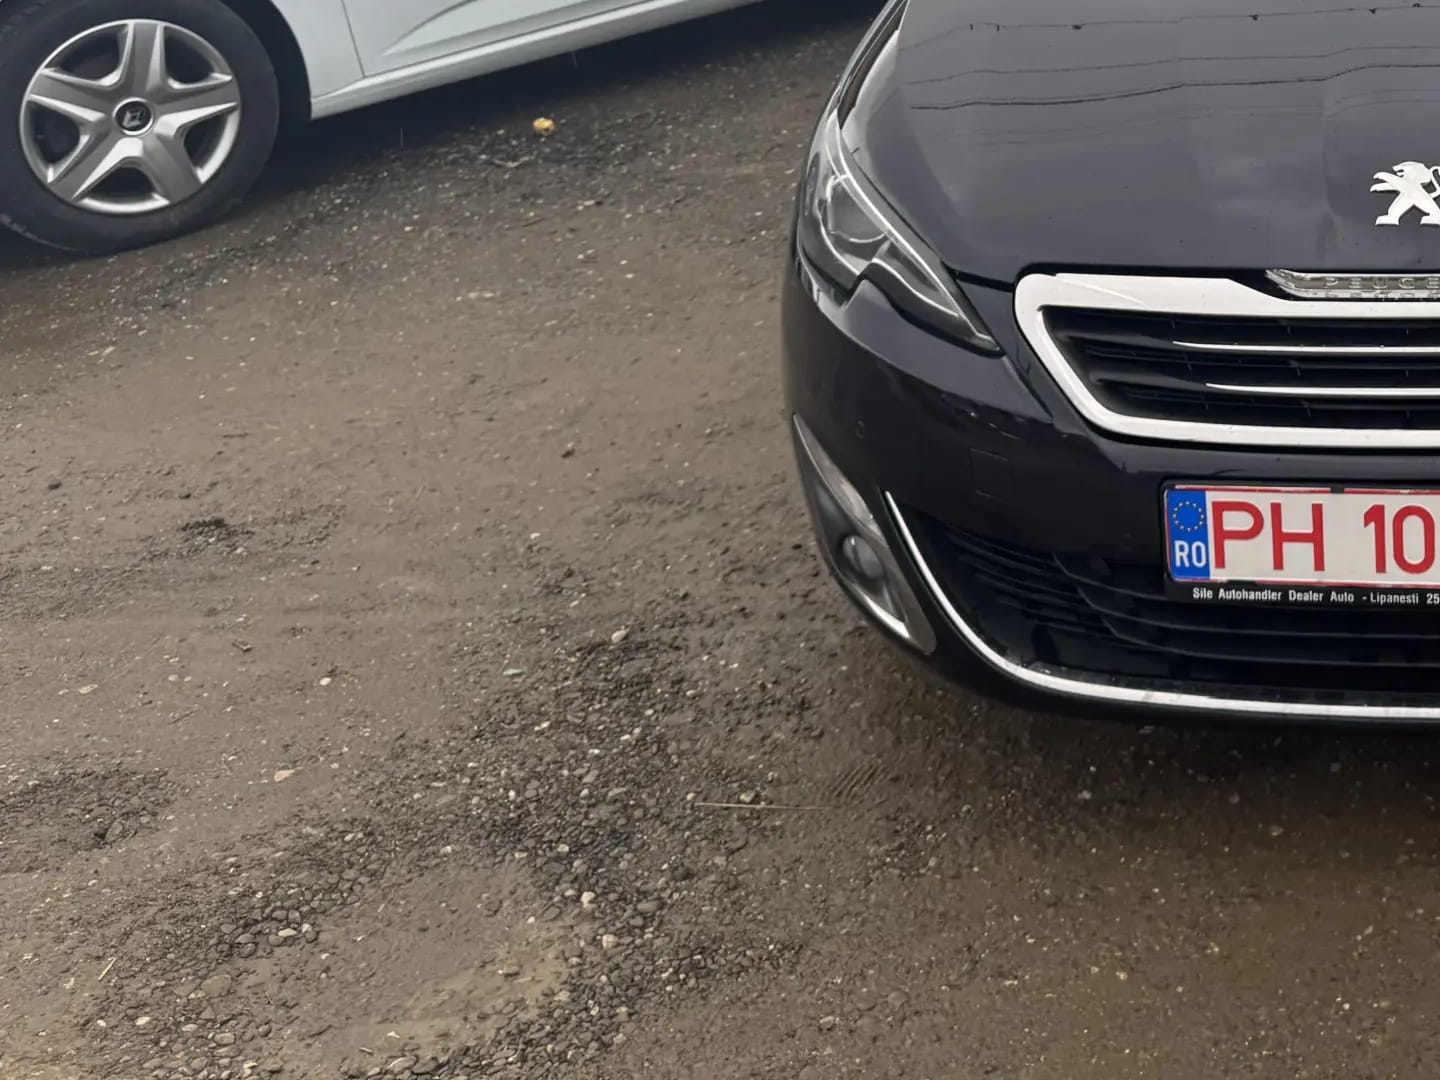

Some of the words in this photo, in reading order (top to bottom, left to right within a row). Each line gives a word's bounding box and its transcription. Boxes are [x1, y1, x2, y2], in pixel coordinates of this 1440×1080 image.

[1211, 500, 1326, 572] PH
[1174, 540, 1207, 568] RO
[1192, 587, 1213, 600] Sile
[1218, 588, 1282, 601] Autohandler
[1288, 589, 1324, 602] Dealer
[1330, 591, 1355, 603] Auto
